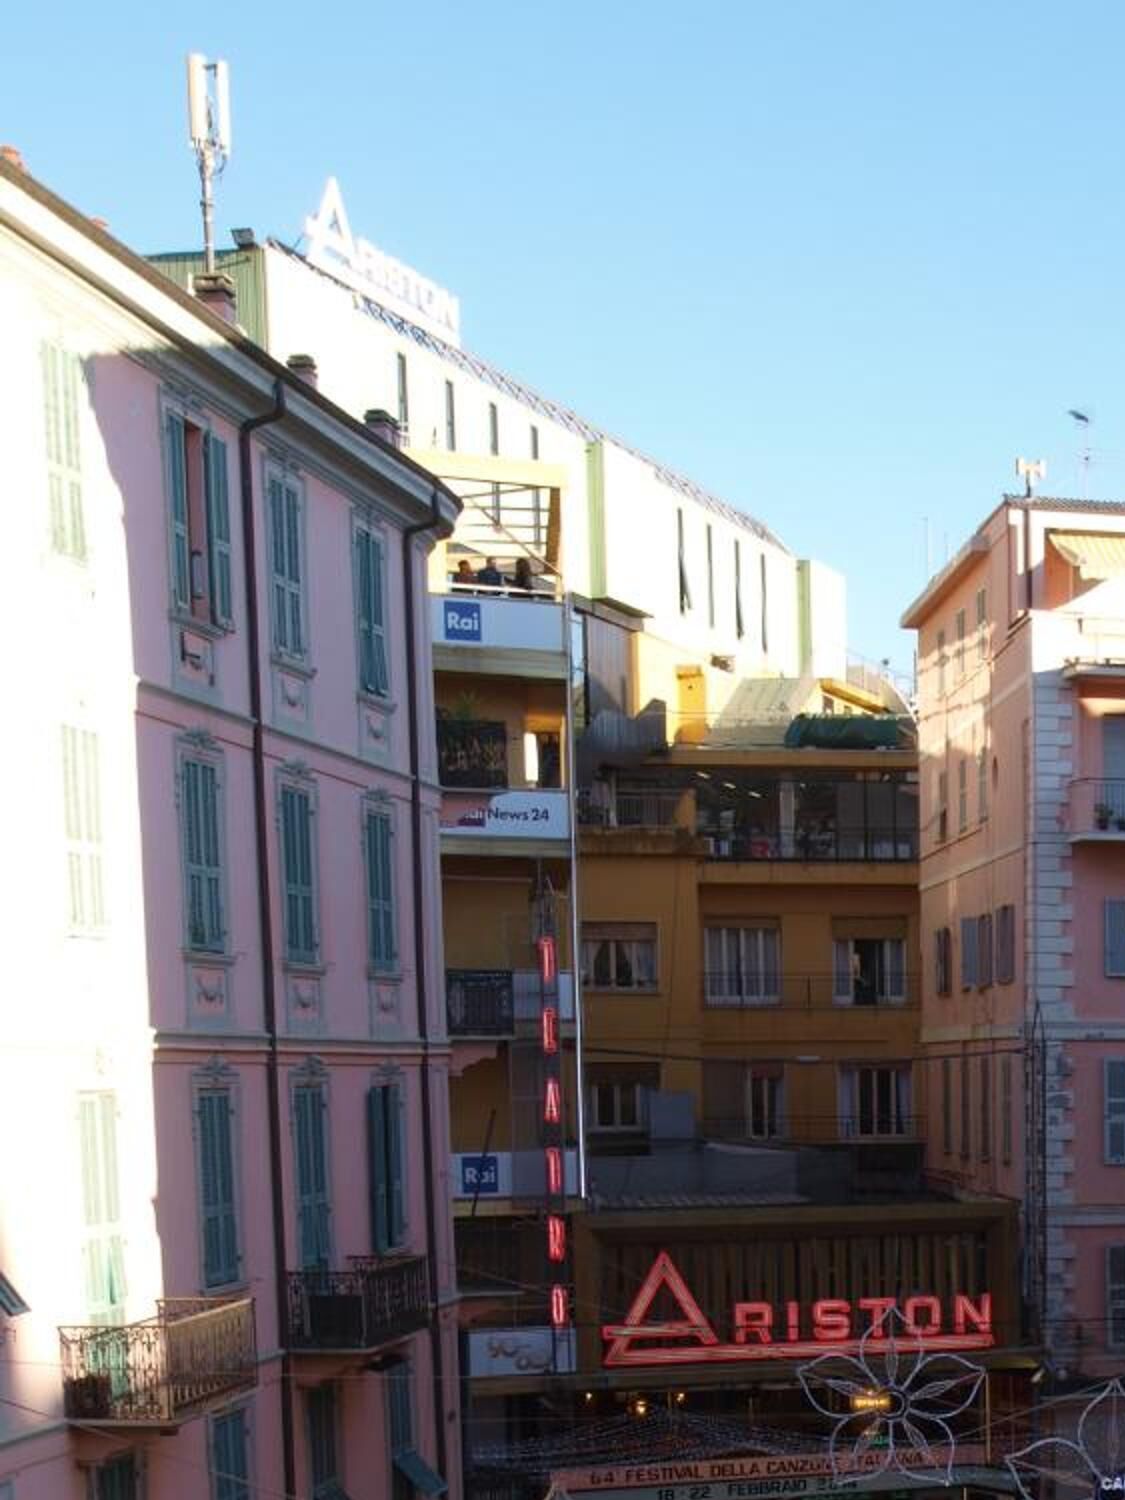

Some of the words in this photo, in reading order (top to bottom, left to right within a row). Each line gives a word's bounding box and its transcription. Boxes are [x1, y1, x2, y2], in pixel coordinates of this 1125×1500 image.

[447, 612, 479, 631] Rai
[487, 807, 528, 821] News
[532, 808, 549, 821] 24
[538, 934, 569, 1327] TEATRO
[463, 1166, 495, 1184] Rai
[601, 1249, 994, 1366] ARISTON
[625, 1464, 704, 1483] FESTIVAL
[710, 1461, 761, 1478] DELLA
[690, 1486, 711, 1500] 22
[728, 1479, 807, 1497] FEBBRAIO
